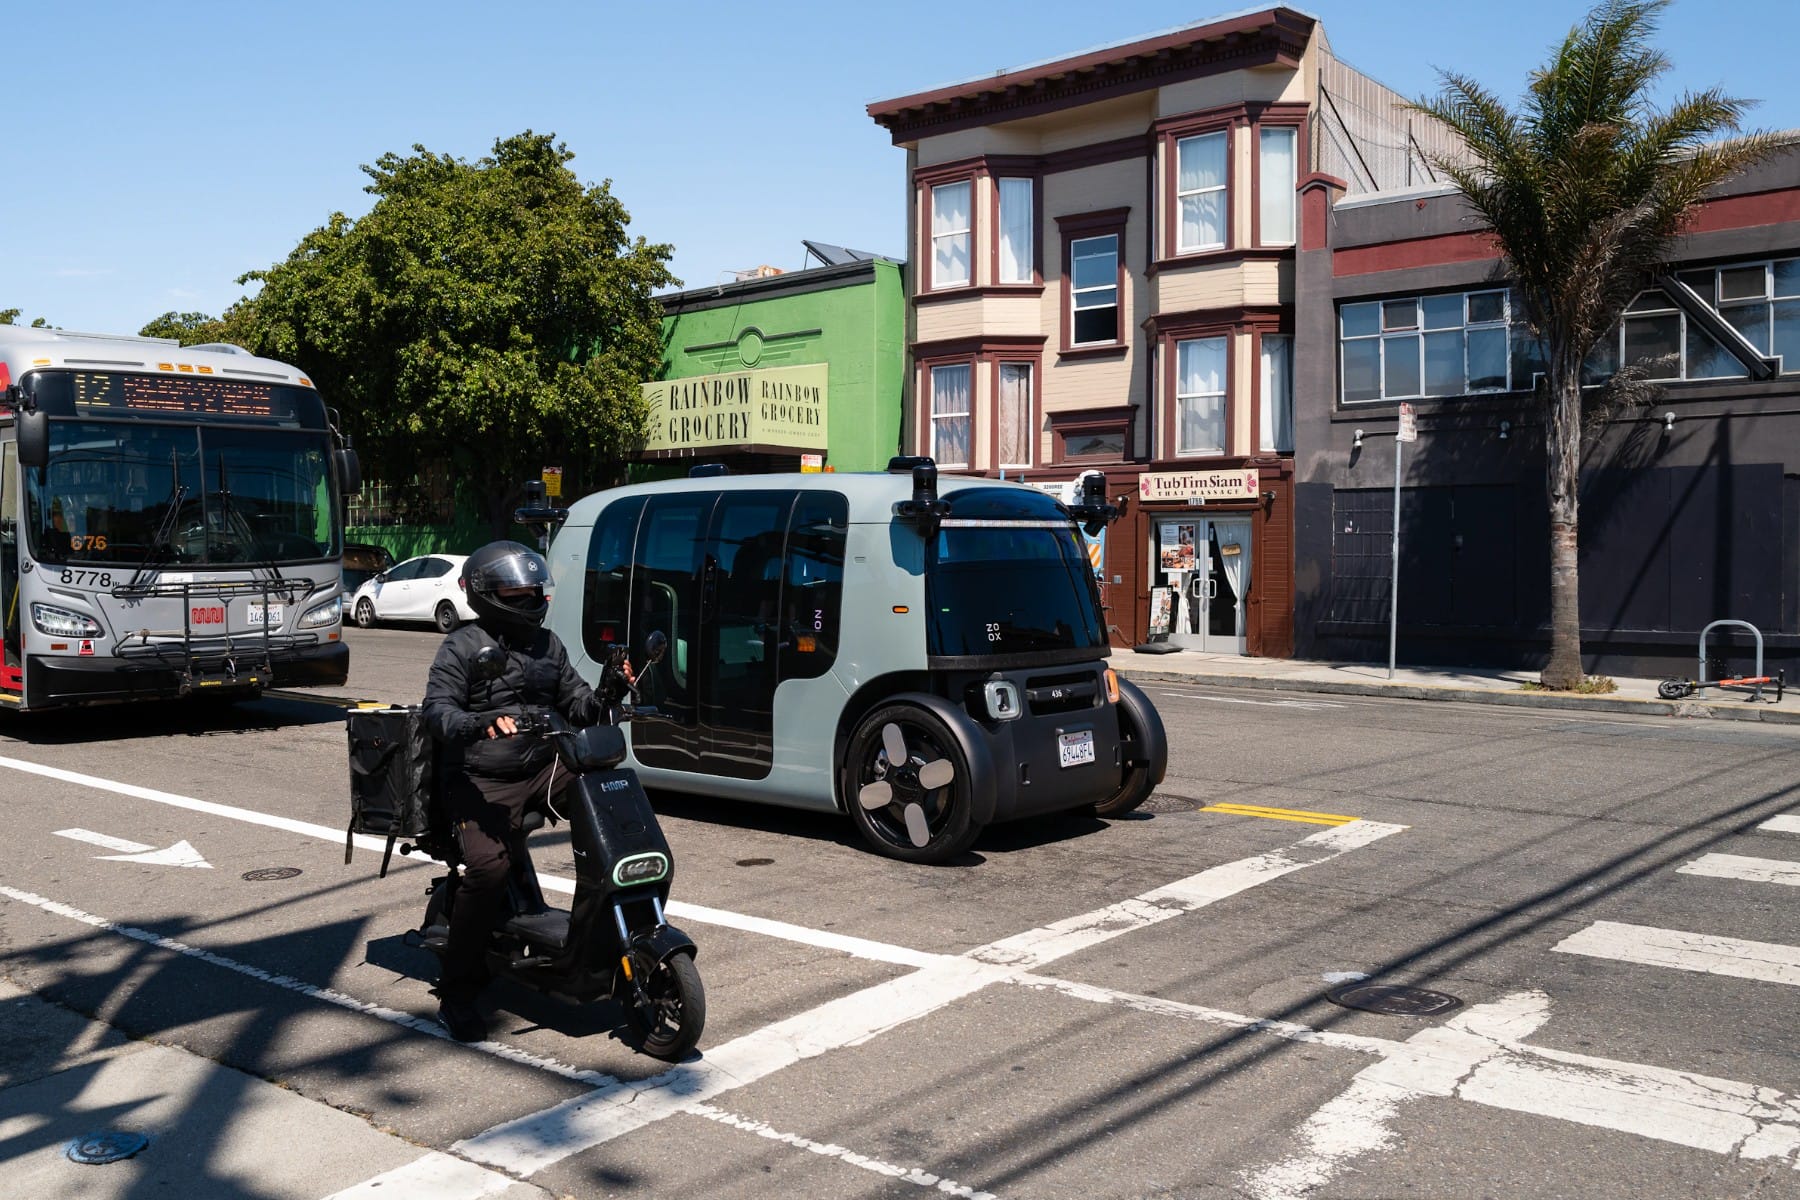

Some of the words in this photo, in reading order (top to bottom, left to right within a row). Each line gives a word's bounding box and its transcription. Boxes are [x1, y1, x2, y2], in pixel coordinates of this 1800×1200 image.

[670, 377, 751, 411] RAINBOW
[761, 380, 821, 405] RAINBOW
[761, 402, 821, 426] GROCERY
[669, 411, 751, 443] GROCERY
[70, 535, 108, 551] 676
[60, 569, 112, 588] 8778
